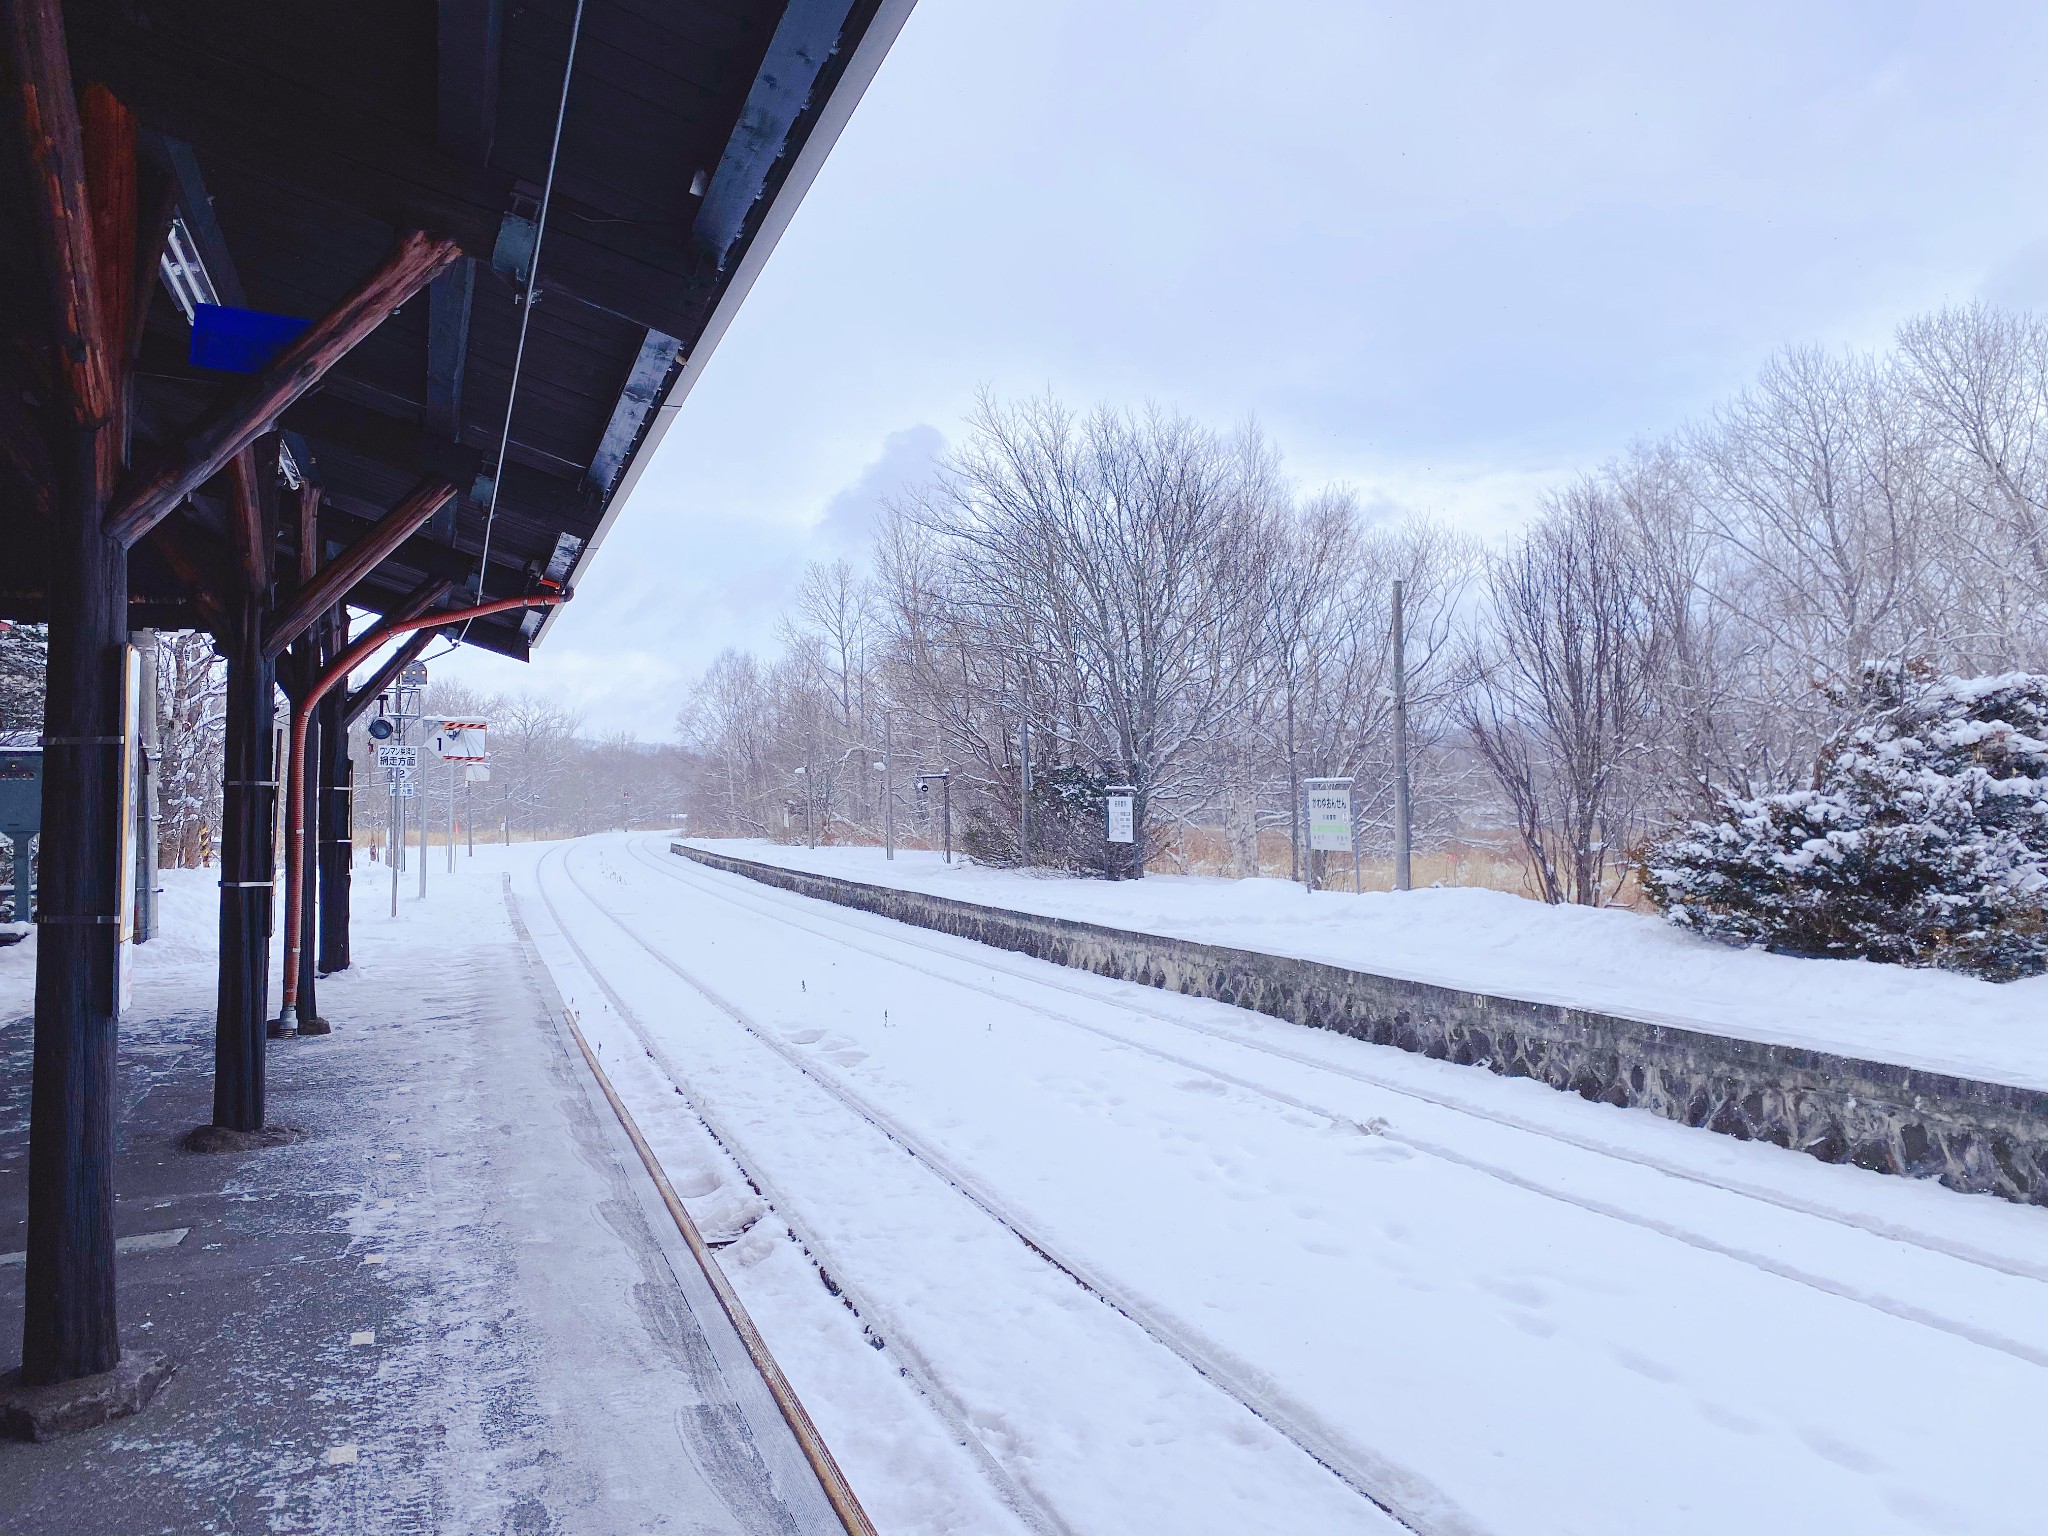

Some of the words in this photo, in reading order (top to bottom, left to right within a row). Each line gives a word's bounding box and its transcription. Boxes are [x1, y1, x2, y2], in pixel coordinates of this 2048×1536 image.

[437, 738, 442, 751] 1
[379, 756, 416, 766] 網走方面
[399, 769, 405, 778] 2
